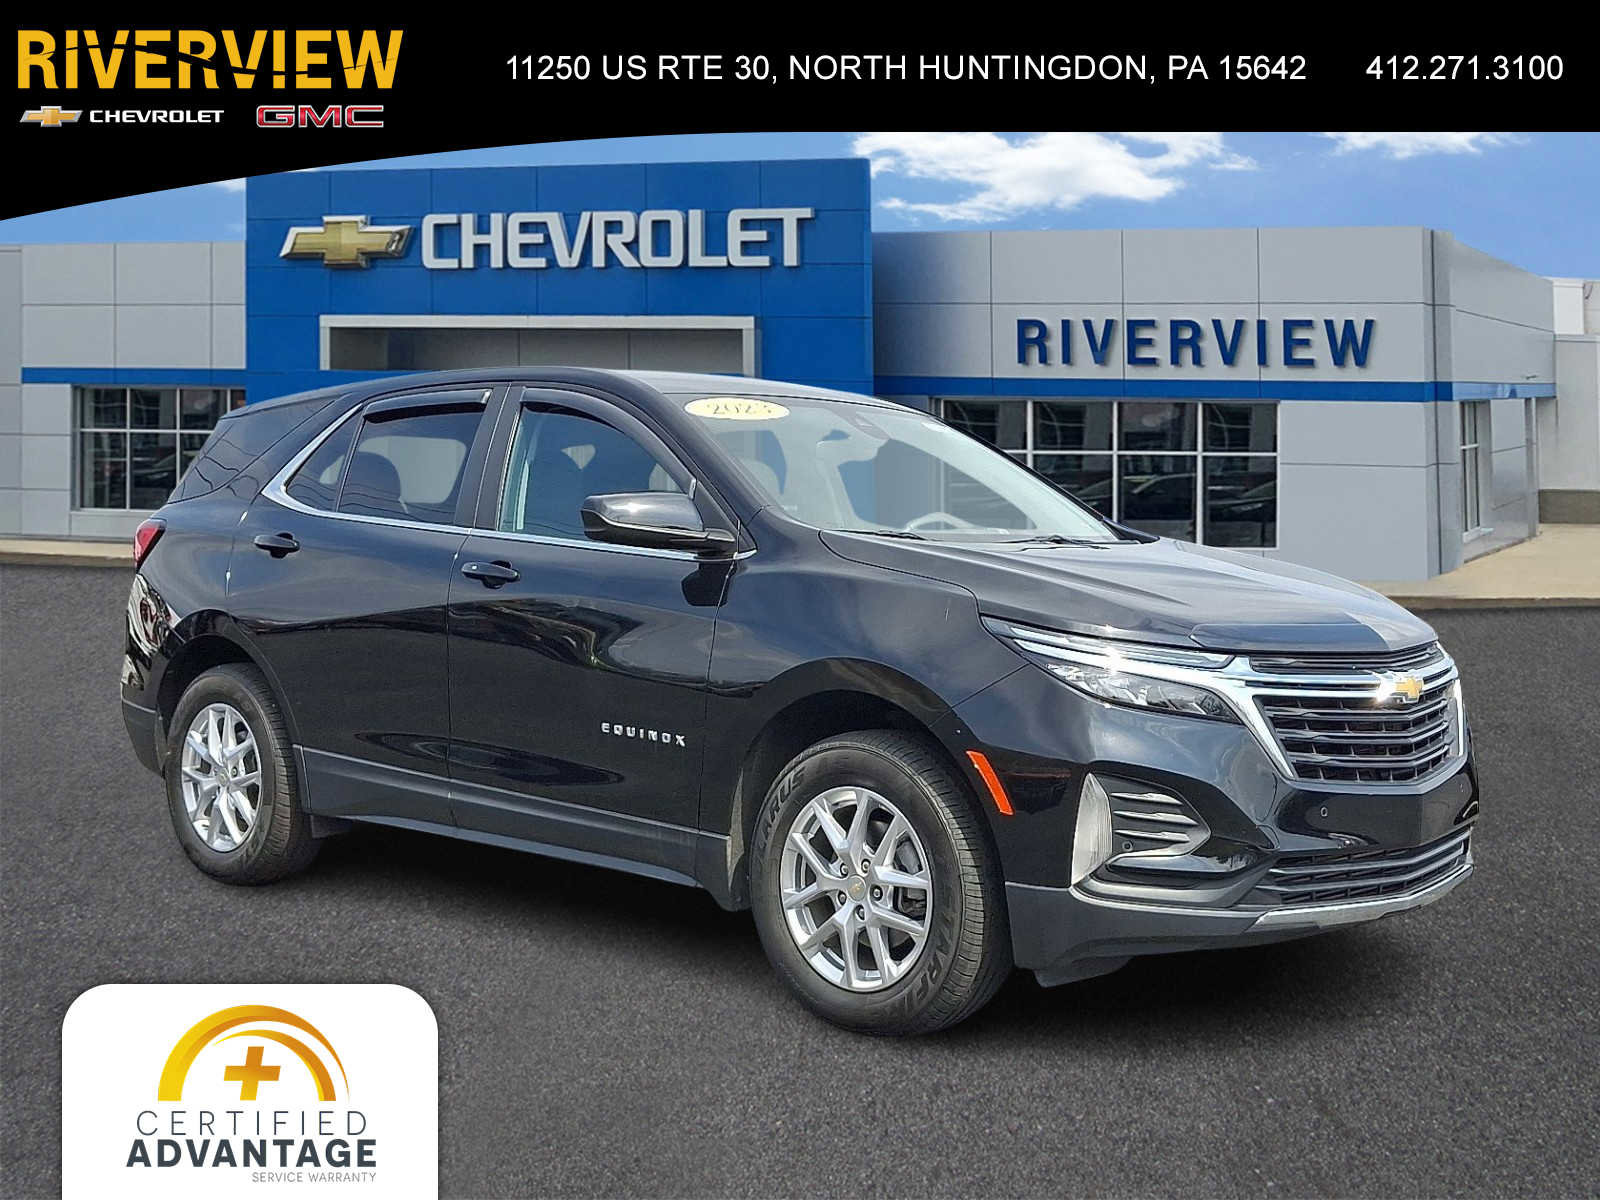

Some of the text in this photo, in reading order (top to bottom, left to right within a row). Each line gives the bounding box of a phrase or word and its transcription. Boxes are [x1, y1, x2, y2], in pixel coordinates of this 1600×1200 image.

[421, 207, 813, 270] CHEVROLET
[1016, 318, 1375, 368] RIVERVIEW
[600, 721, 687, 748] EQUINOX
